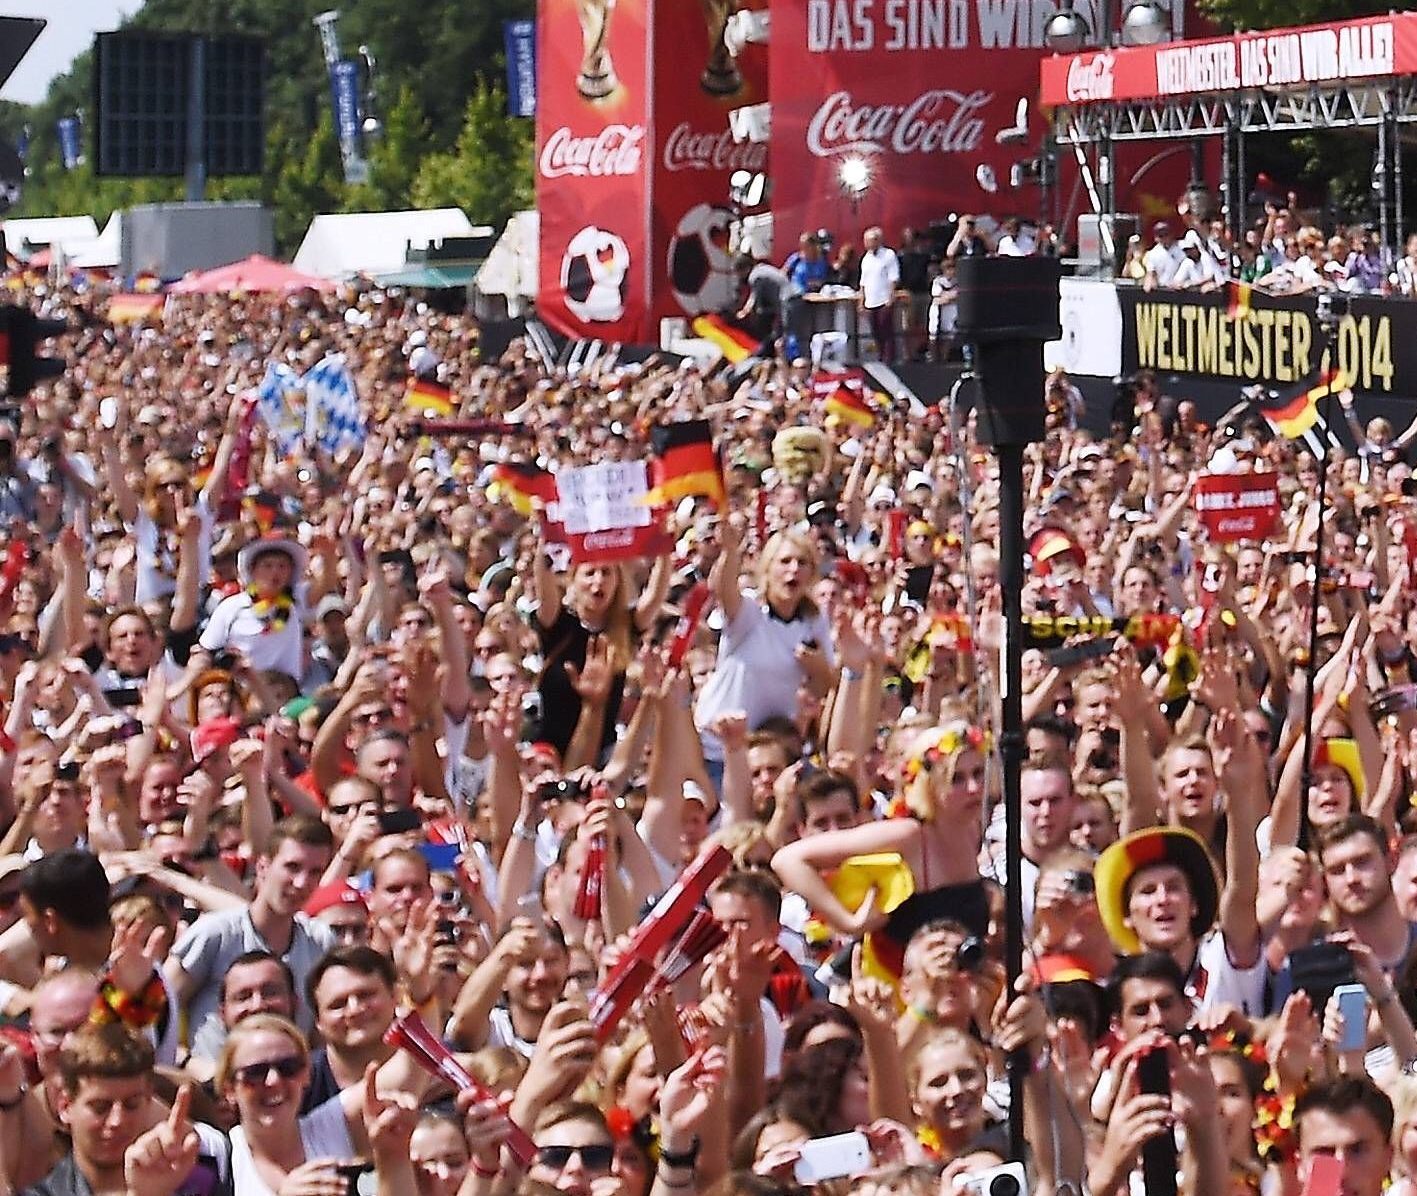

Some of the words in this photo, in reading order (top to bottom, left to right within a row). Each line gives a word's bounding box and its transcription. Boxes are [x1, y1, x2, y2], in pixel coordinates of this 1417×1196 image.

[1240, 37, 1268, 87] DAS
[1267, 33, 1301, 86] SIND
[1300, 28, 1339, 83] WIR
[1338, 21, 1394, 79] ALLE!
[539, 124, 645, 179] Coca-Cola
[806, 90, 997, 157] Coca-Cola
[1135, 302, 1312, 382] WELTMEISTER
